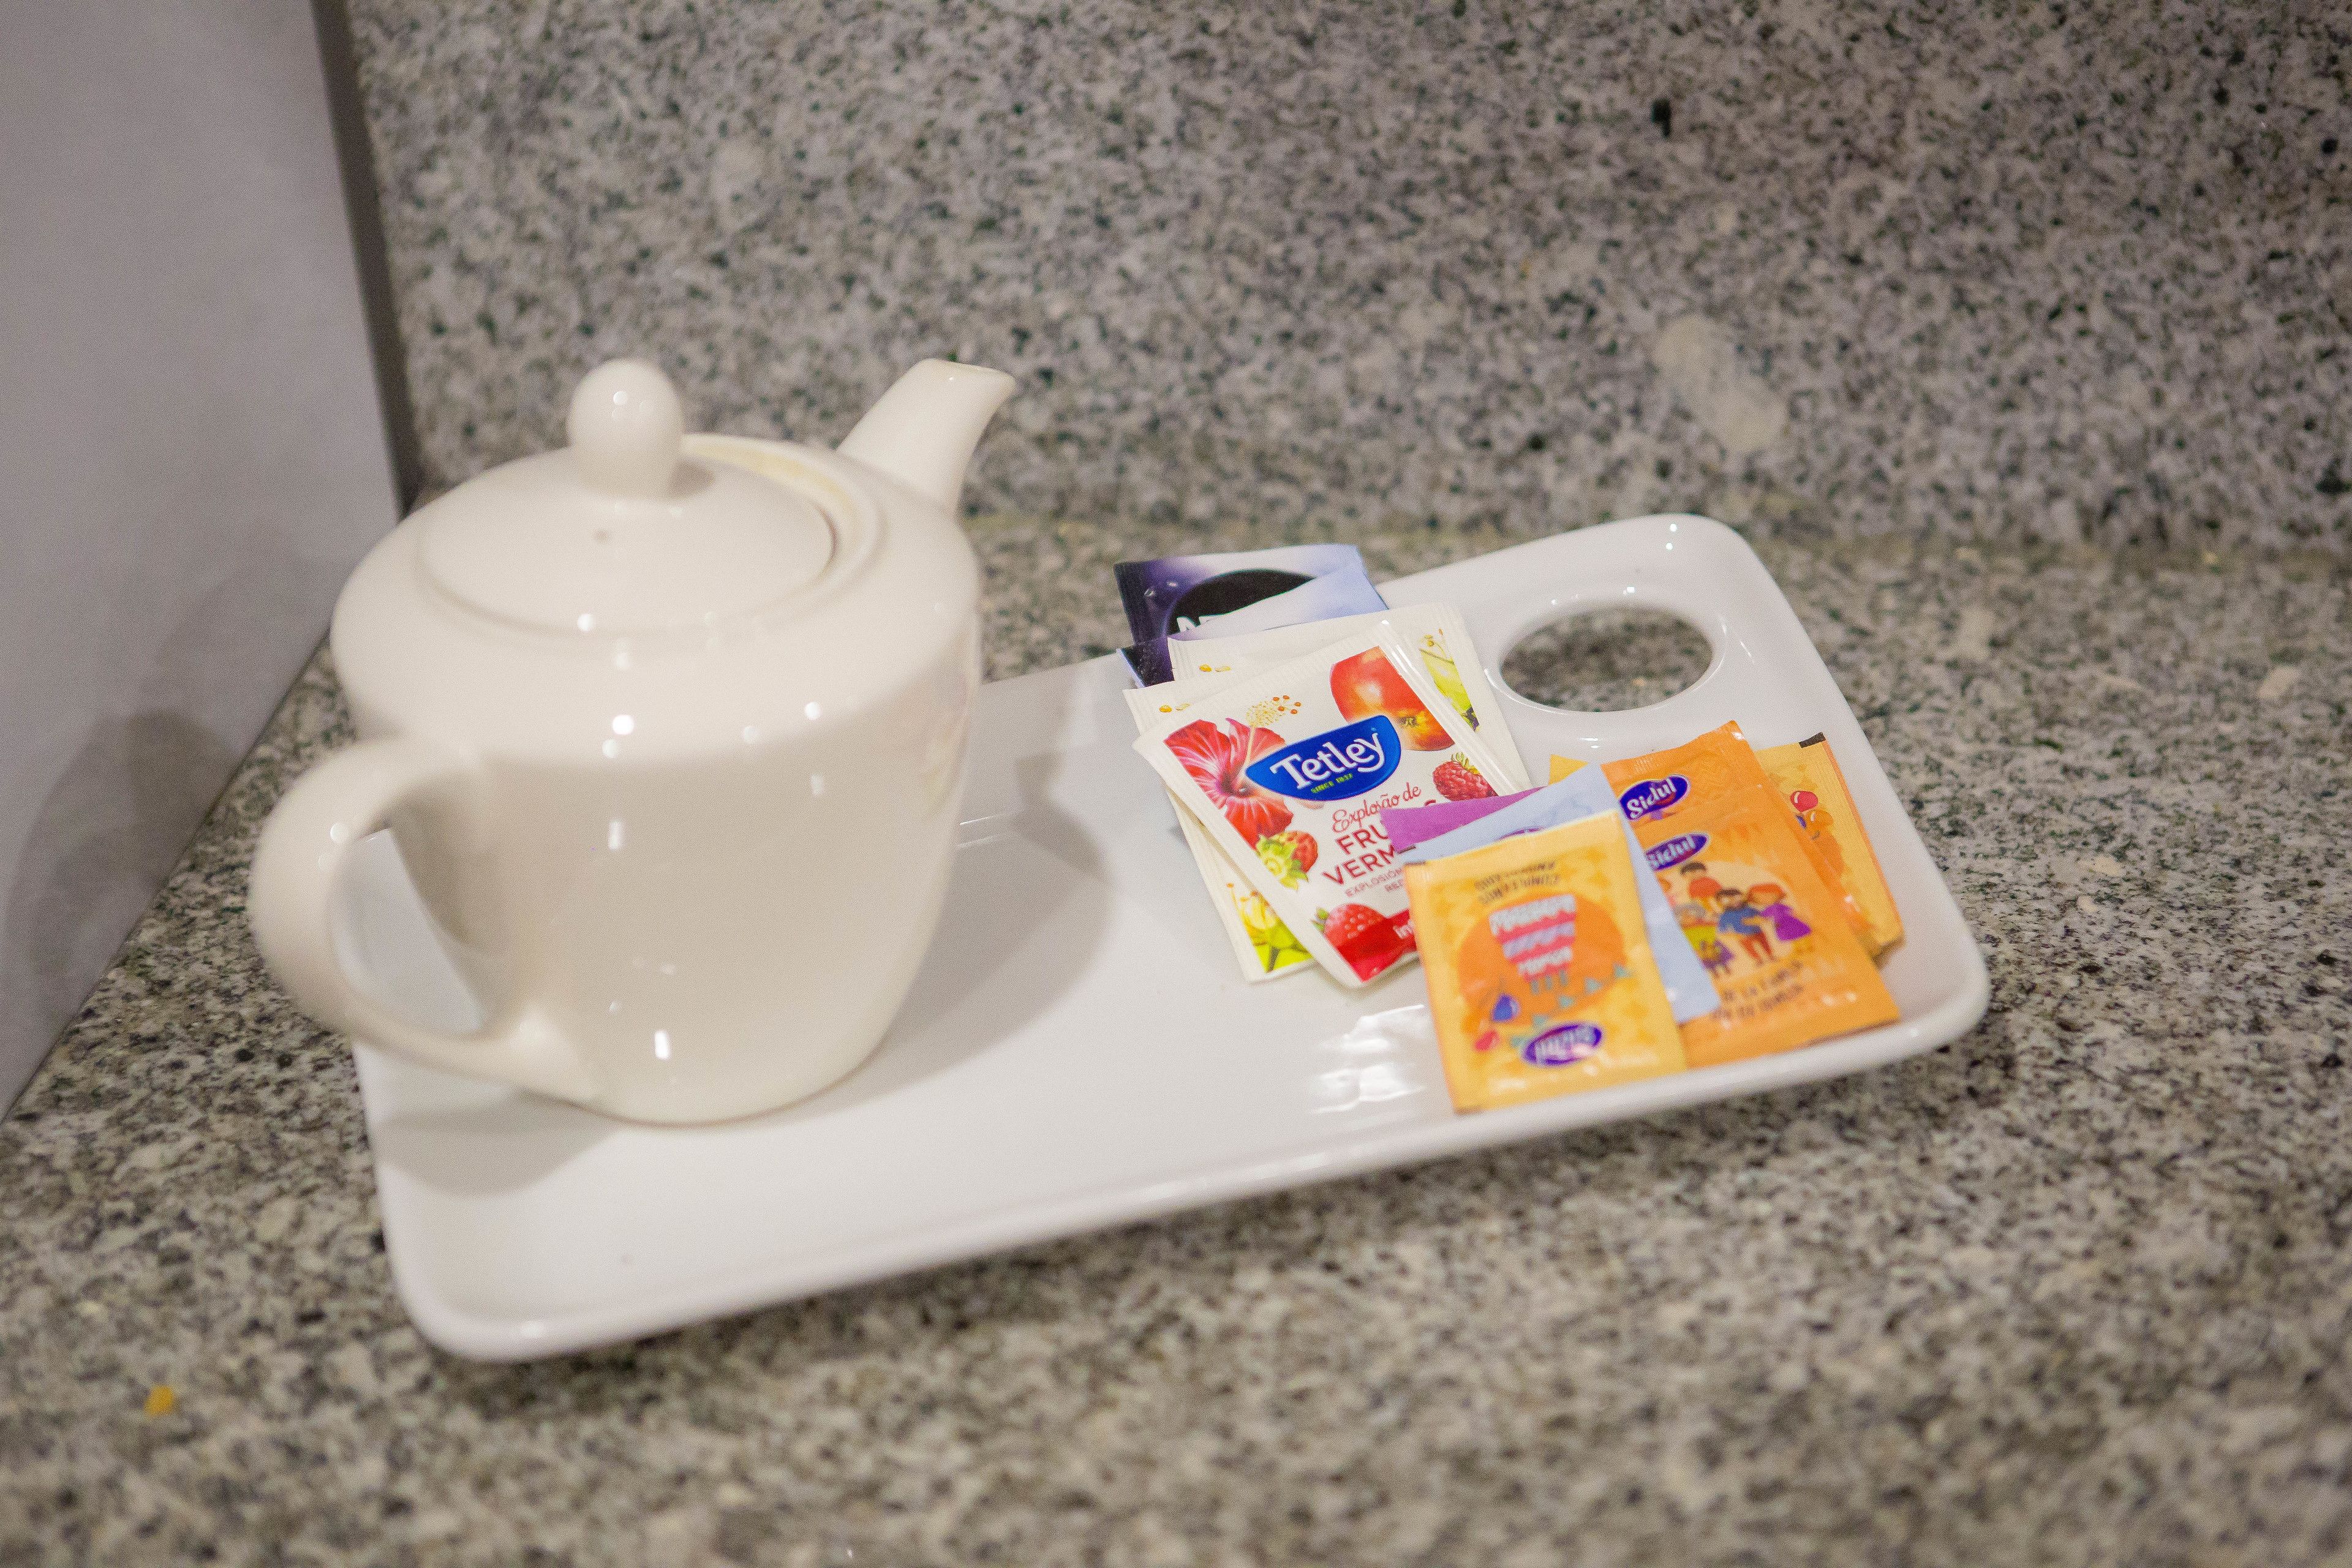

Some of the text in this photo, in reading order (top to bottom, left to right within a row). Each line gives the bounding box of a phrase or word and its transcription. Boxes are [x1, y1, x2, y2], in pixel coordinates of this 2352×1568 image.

[1270, 733, 1385, 790] Tetley
[1332, 782, 1421, 834] Explosão de
[1627, 777, 1676, 818] Sidul
